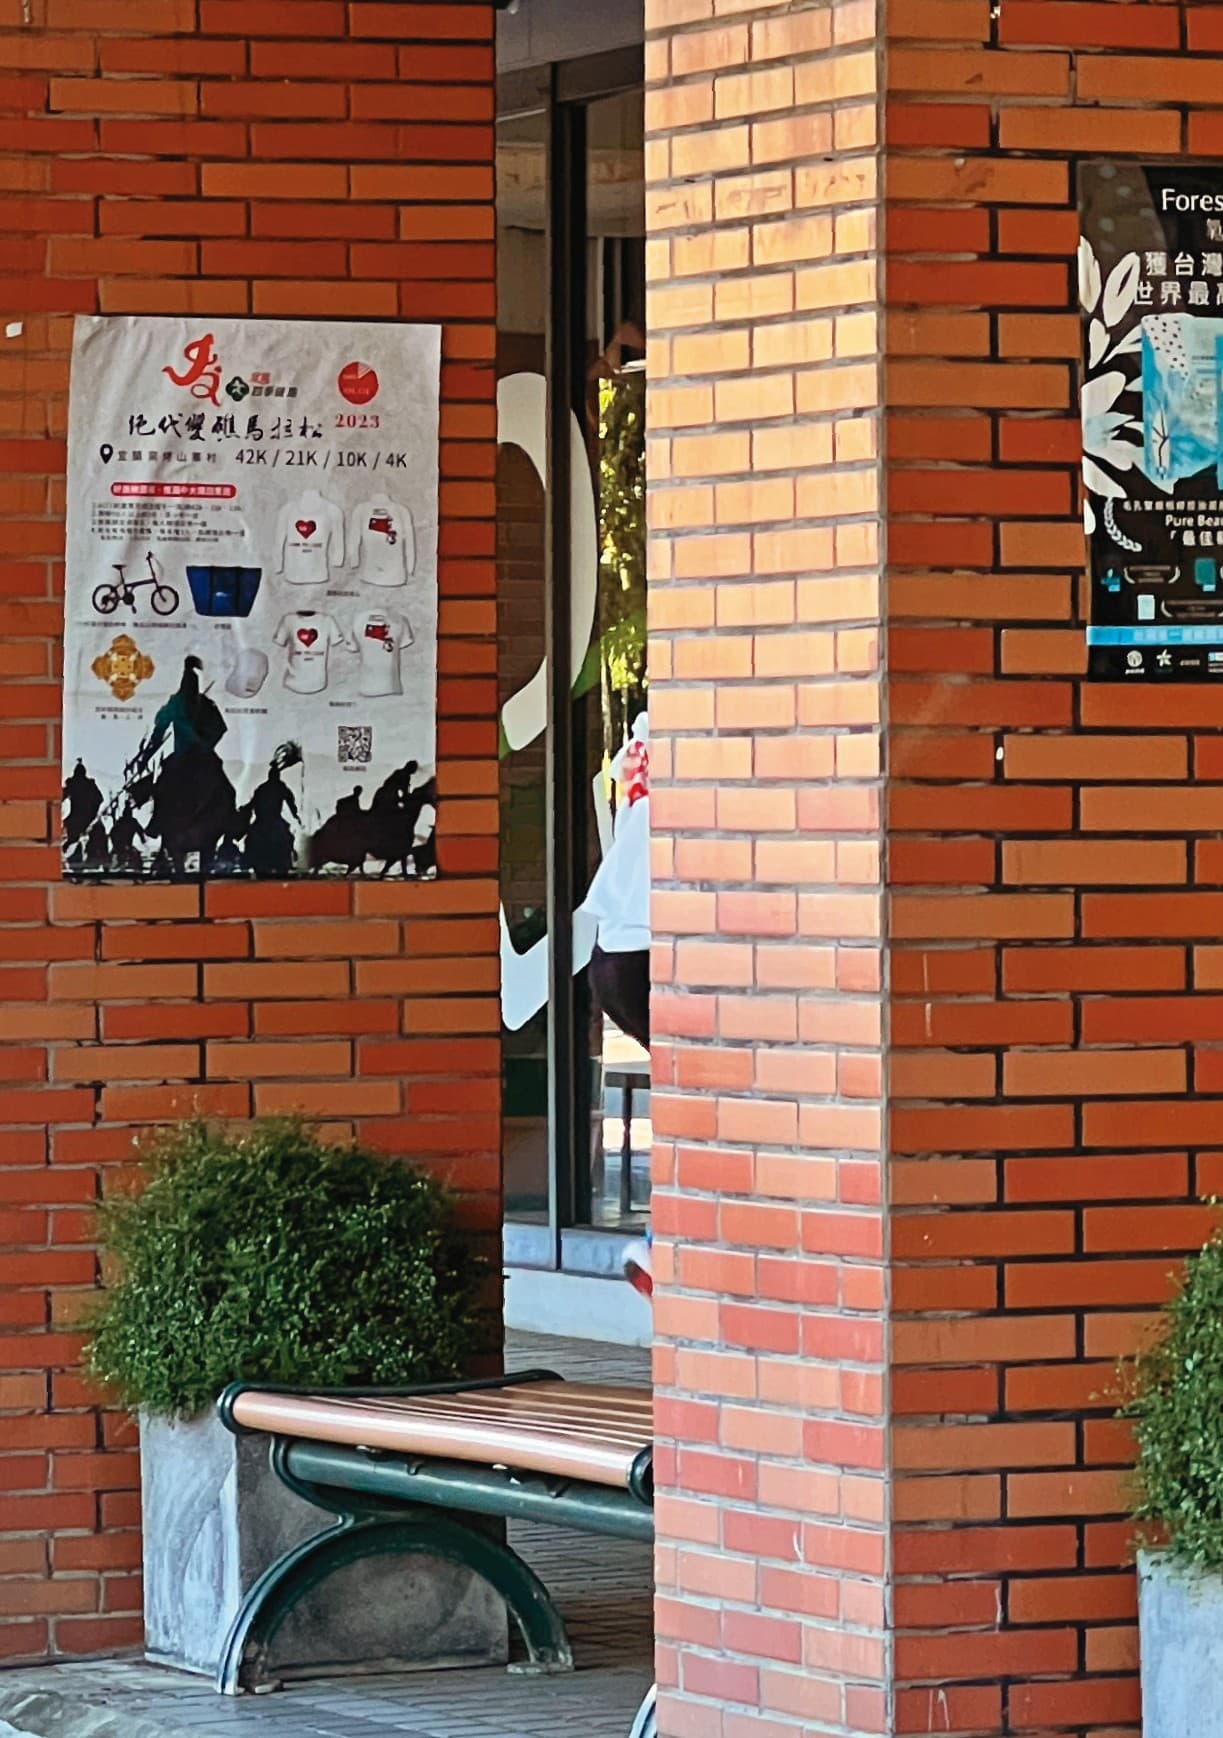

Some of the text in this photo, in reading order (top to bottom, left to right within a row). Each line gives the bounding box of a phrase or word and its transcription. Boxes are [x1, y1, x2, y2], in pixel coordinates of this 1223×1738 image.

[334, 413, 380, 429] 2023
[235, 449, 268, 466] 42K
[285, 450, 318, 467] 21K
[336, 451, 368, 468] 10K
[385, 452, 408, 469] 4K
[1165, 513, 1194, 527] Pure
